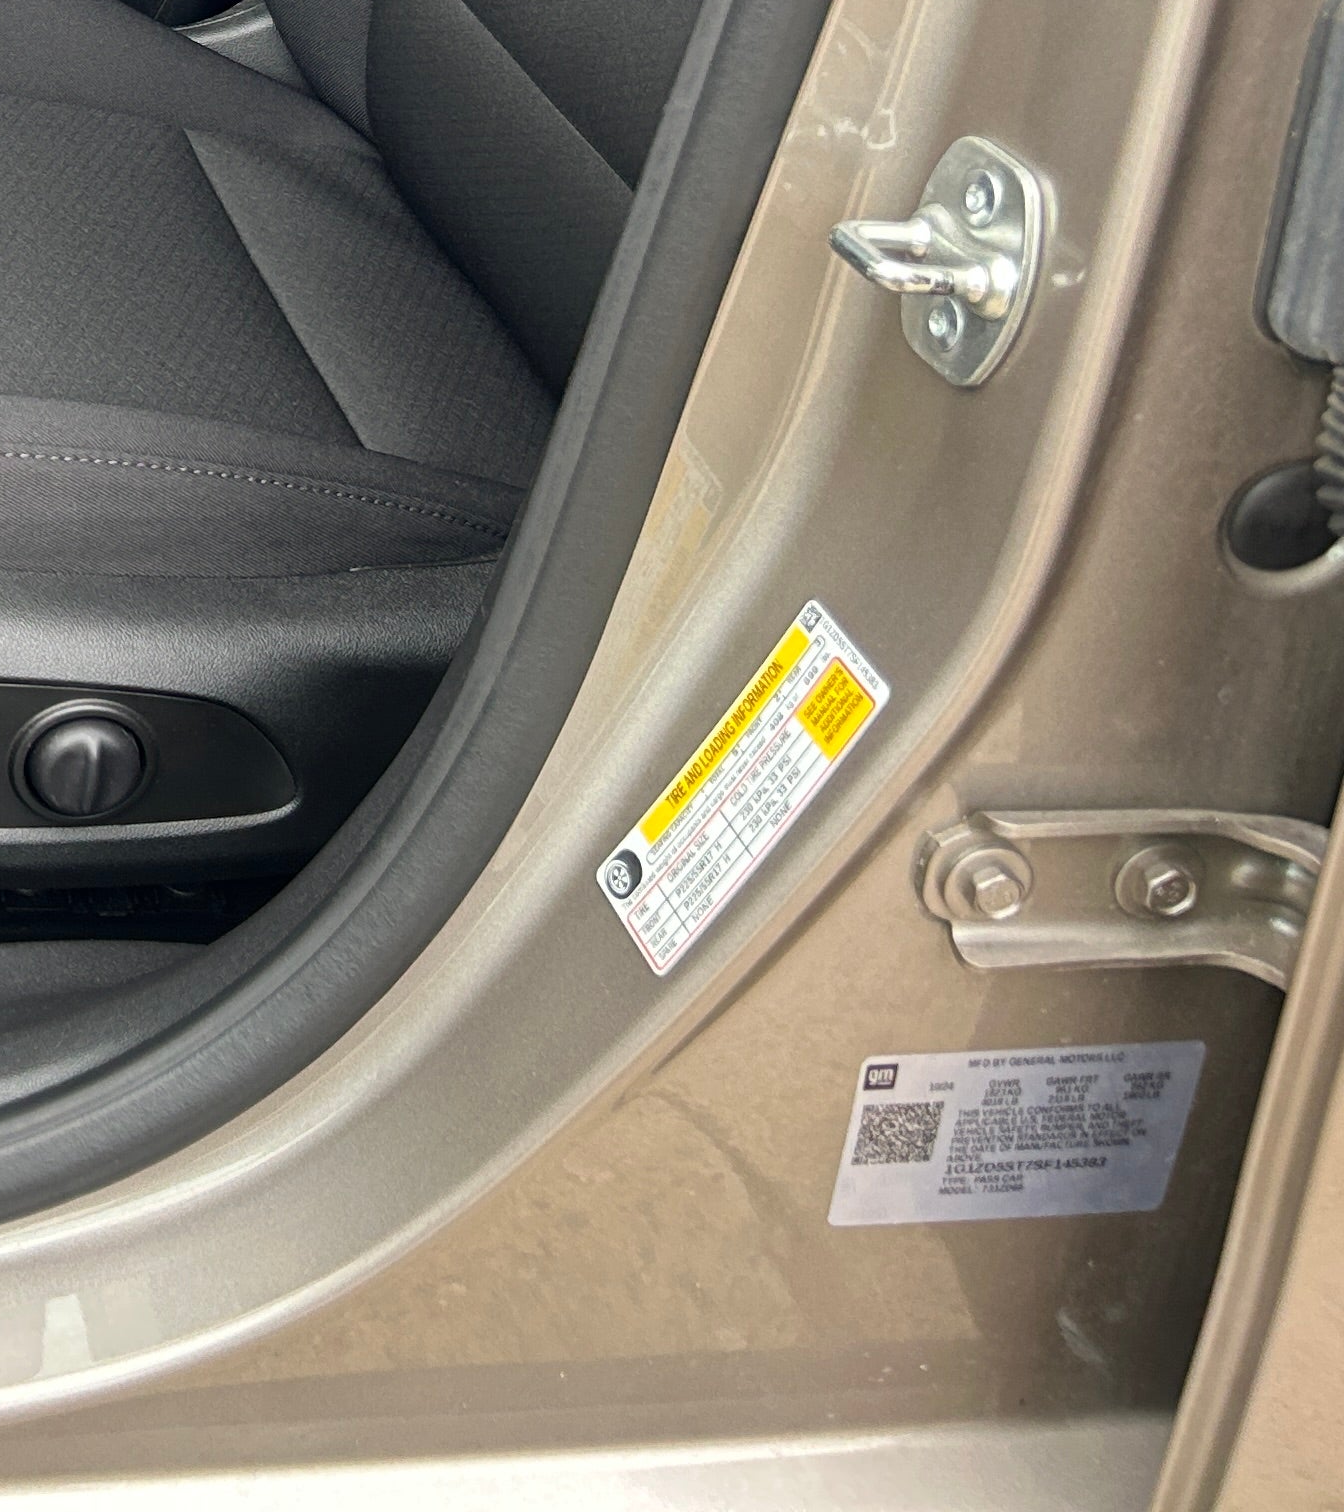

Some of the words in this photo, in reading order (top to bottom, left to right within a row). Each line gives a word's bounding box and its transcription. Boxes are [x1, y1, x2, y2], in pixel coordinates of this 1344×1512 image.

[802, 699, 818, 720] SEE
[813, 665, 845, 705] OWNER'S
[809, 692, 837, 727] MANUAL
[832, 675, 850, 696] FOR
[817, 686, 855, 733] ADDITIONAL
[822, 692, 865, 745] INFORMATION
[664, 779, 688, 812] TIRE
[681, 759, 705, 790] AND
[697, 718, 737, 770] LOADING
[728, 656, 785, 728] INFORMATION
[738, 801, 754, 821] 230
[767, 770, 779, 786] 33
[776, 752, 793, 773] PSI
[747, 813, 763, 833] 230
[775, 782, 788, 798] 33
[785, 764, 802, 785] PSI
[633, 900, 650, 922] TIRE
[665, 845, 696, 885] ORIGINAL
[692, 829, 710, 852] SIZE
[728, 780, 749, 807] COLD
[745, 764, 762, 786] TIRE
[757, 726, 792, 771] PRESSURE
[691, 893, 714, 924] NONE
[769, 799, 793, 829] NONE
[865, 1067, 895, 1086] gm
[1007, 1054, 1057, 1067] GENERAL
[1058, 1052, 1104, 1064] MOTORS
